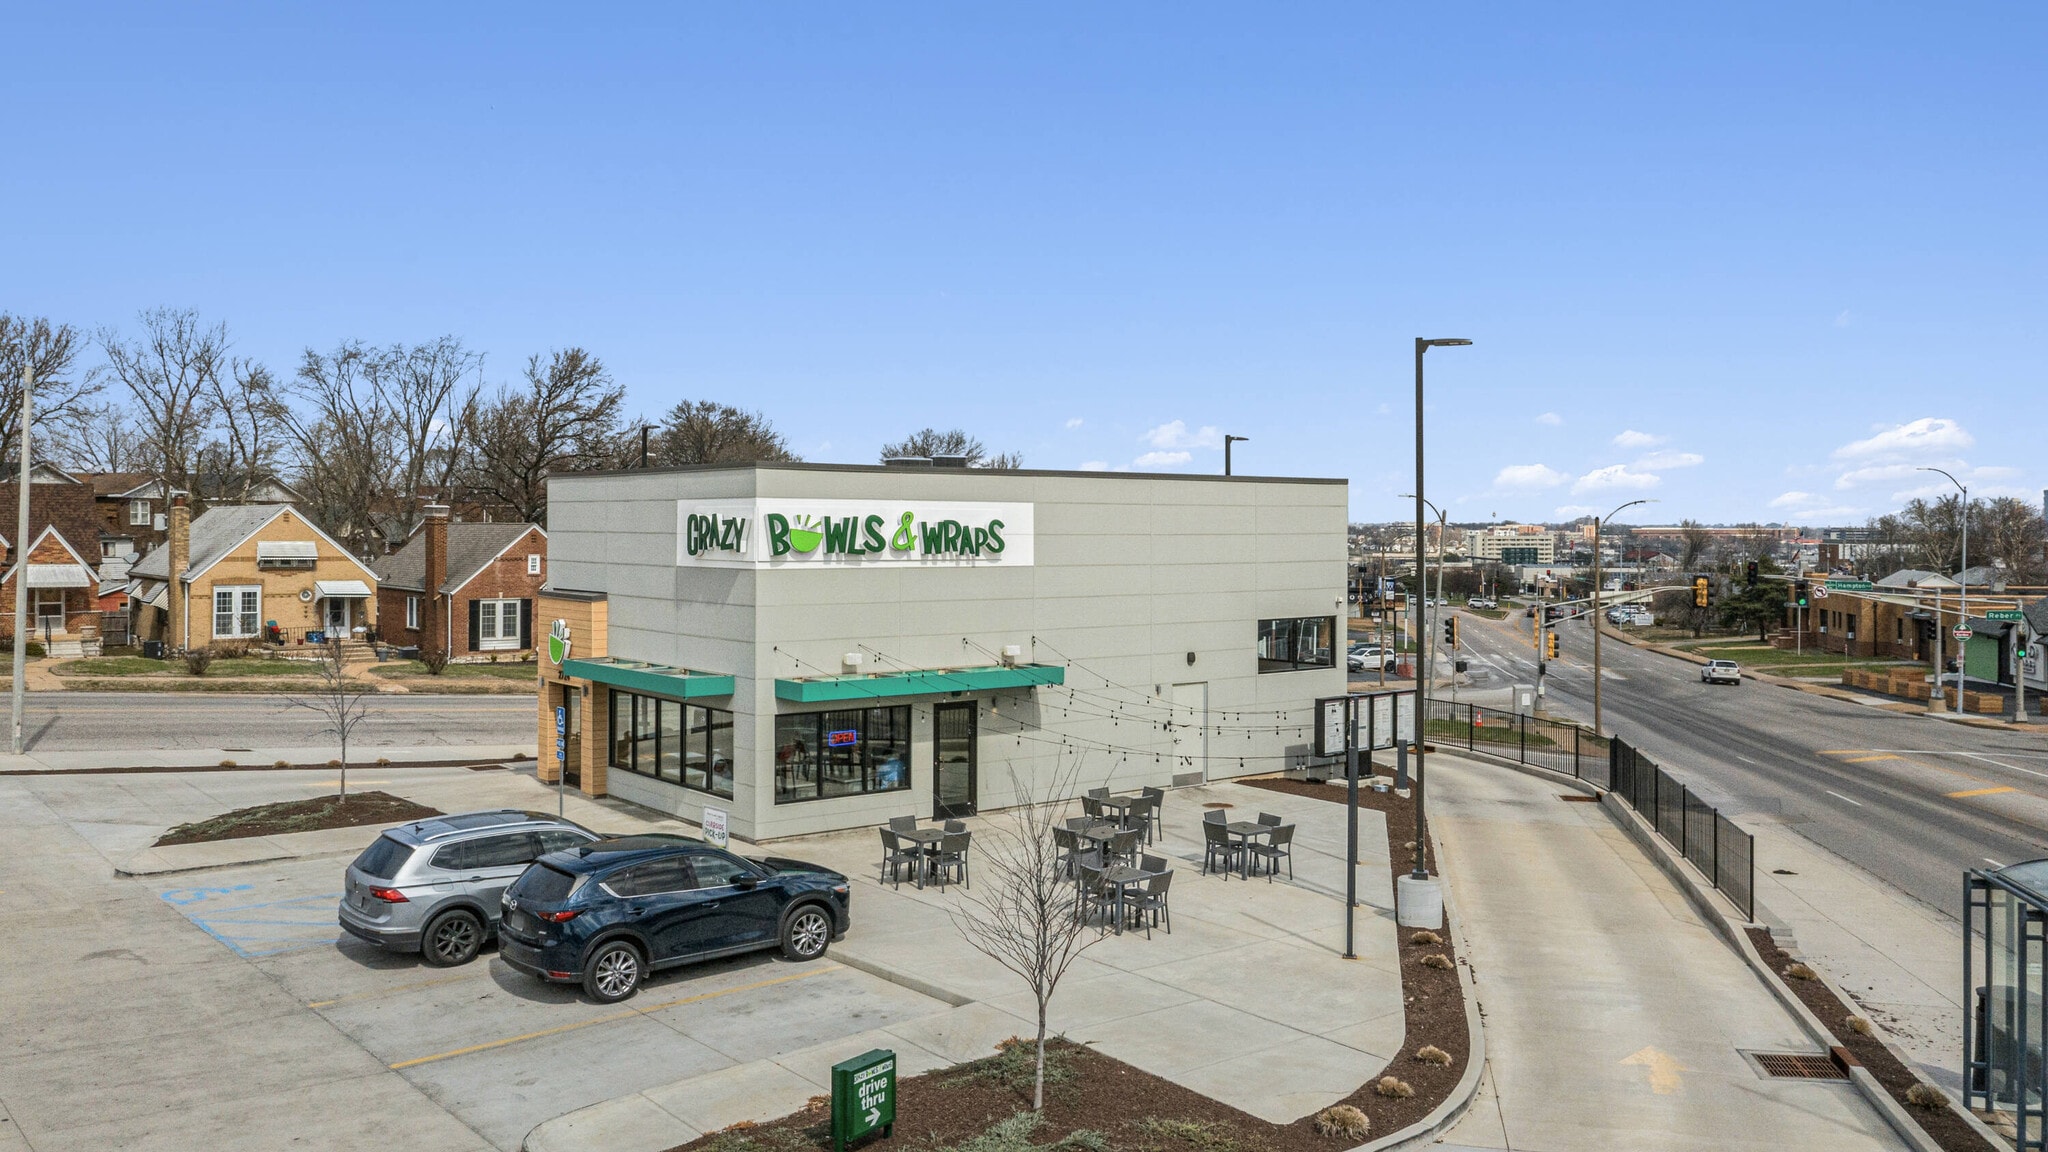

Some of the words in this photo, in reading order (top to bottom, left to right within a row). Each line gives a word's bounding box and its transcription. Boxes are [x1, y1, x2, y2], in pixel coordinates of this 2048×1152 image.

[686, 513, 746, 557] CRAZY
[892, 510, 917, 552] &
[919, 518, 1006, 557] WRAPS
[831, 732, 855, 745] OPEN
[858, 1077, 888, 1098] drive
[861, 1091, 885, 1110] thru
